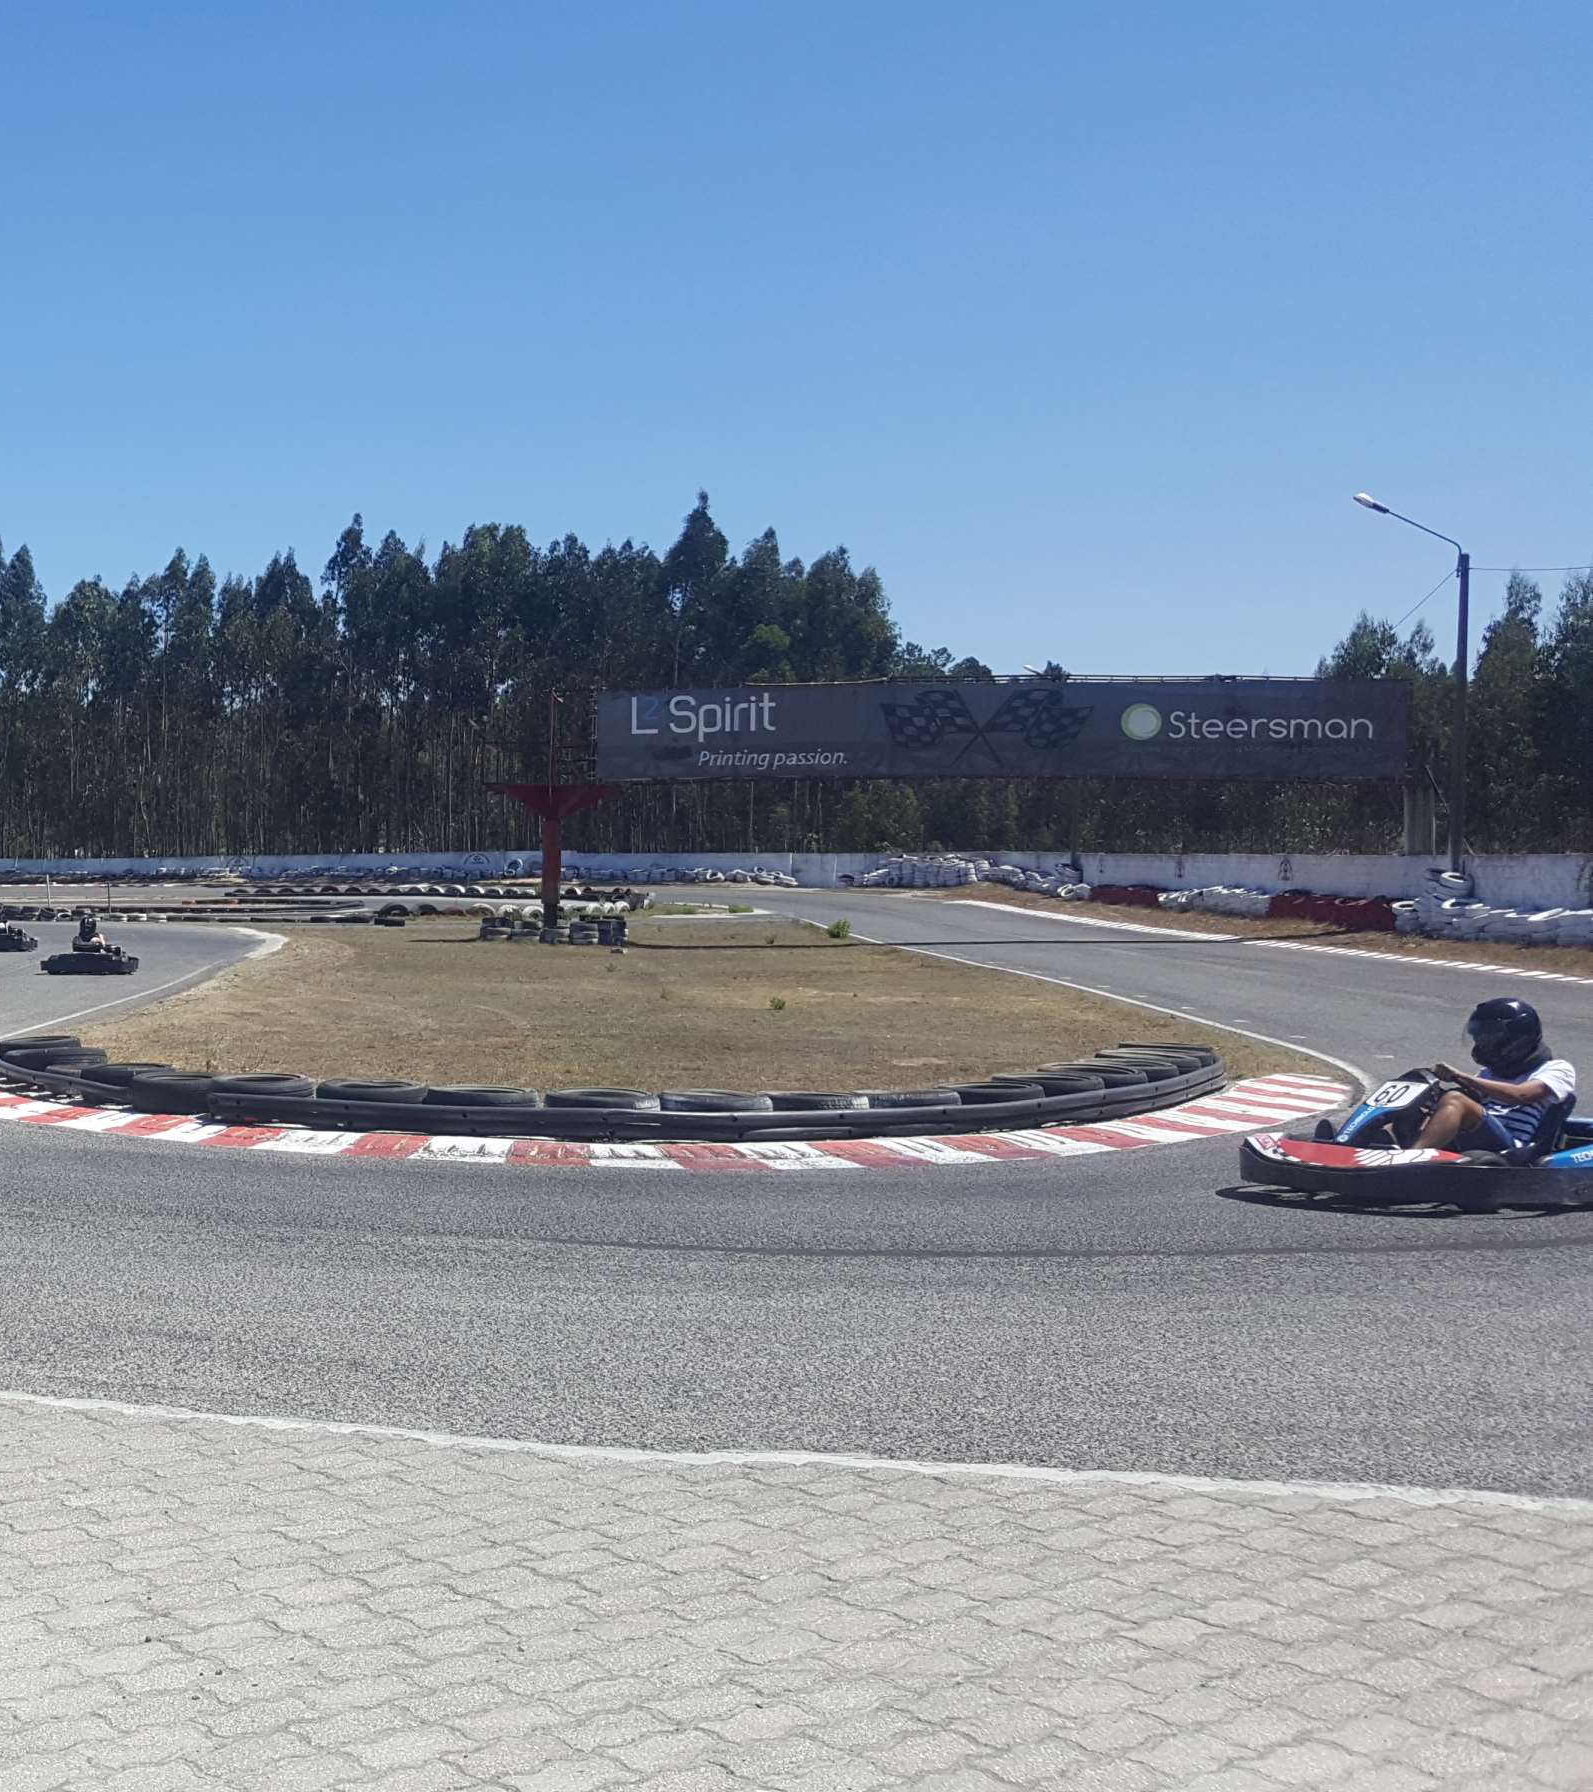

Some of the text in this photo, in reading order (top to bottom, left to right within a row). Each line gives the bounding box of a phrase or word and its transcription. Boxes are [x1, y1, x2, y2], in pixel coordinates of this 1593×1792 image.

[669, 692, 777, 743] Spirit
[1168, 710, 1374, 739] Steersman
[698, 748, 847, 770] Printing passion.
[1373, 1084, 1410, 1104] 60
